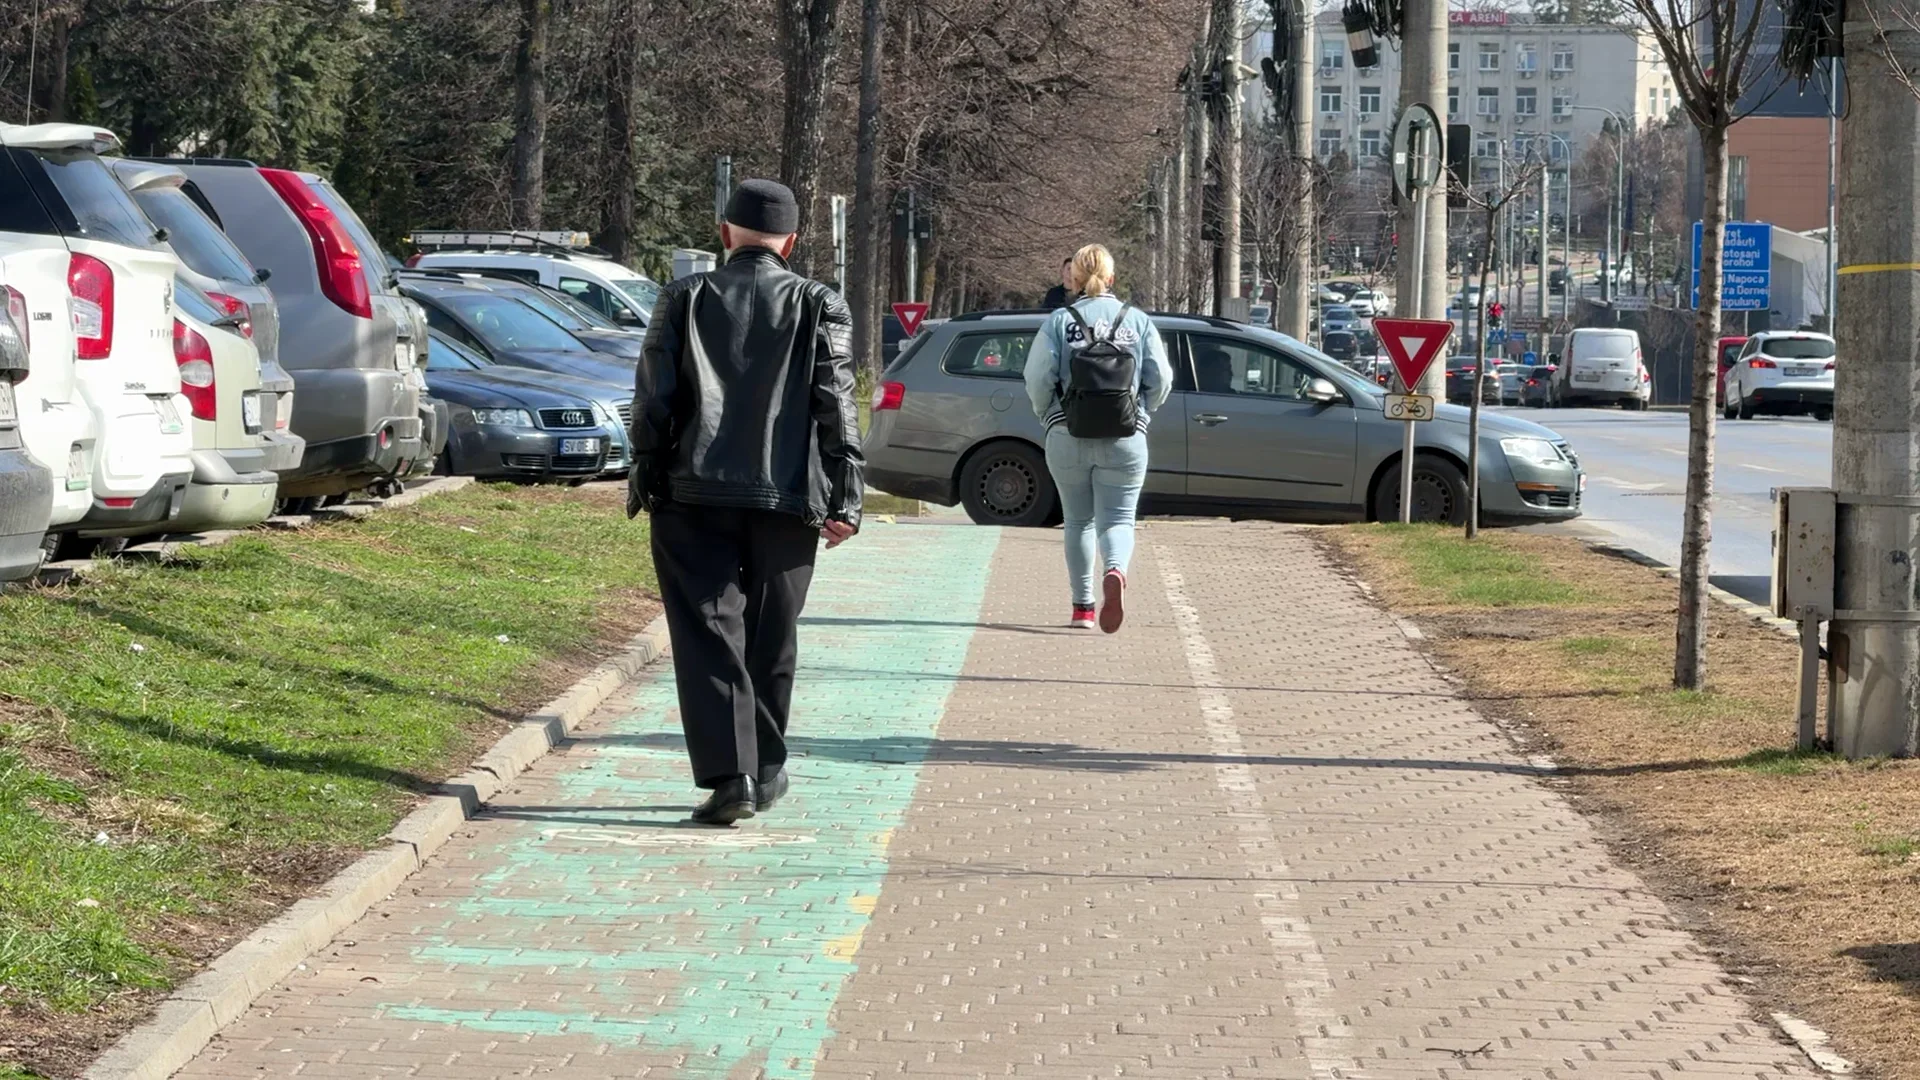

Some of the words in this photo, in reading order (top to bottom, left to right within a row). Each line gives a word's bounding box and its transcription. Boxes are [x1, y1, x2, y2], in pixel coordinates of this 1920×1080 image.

[1449, 13, 1463, 23] CA
[1470, 13, 1504, 23] ARENI
[1723, 248, 1760, 259] otosani
[1723, 256, 1754, 267] orohoi
[1727, 273, 1764, 286] Napoca
